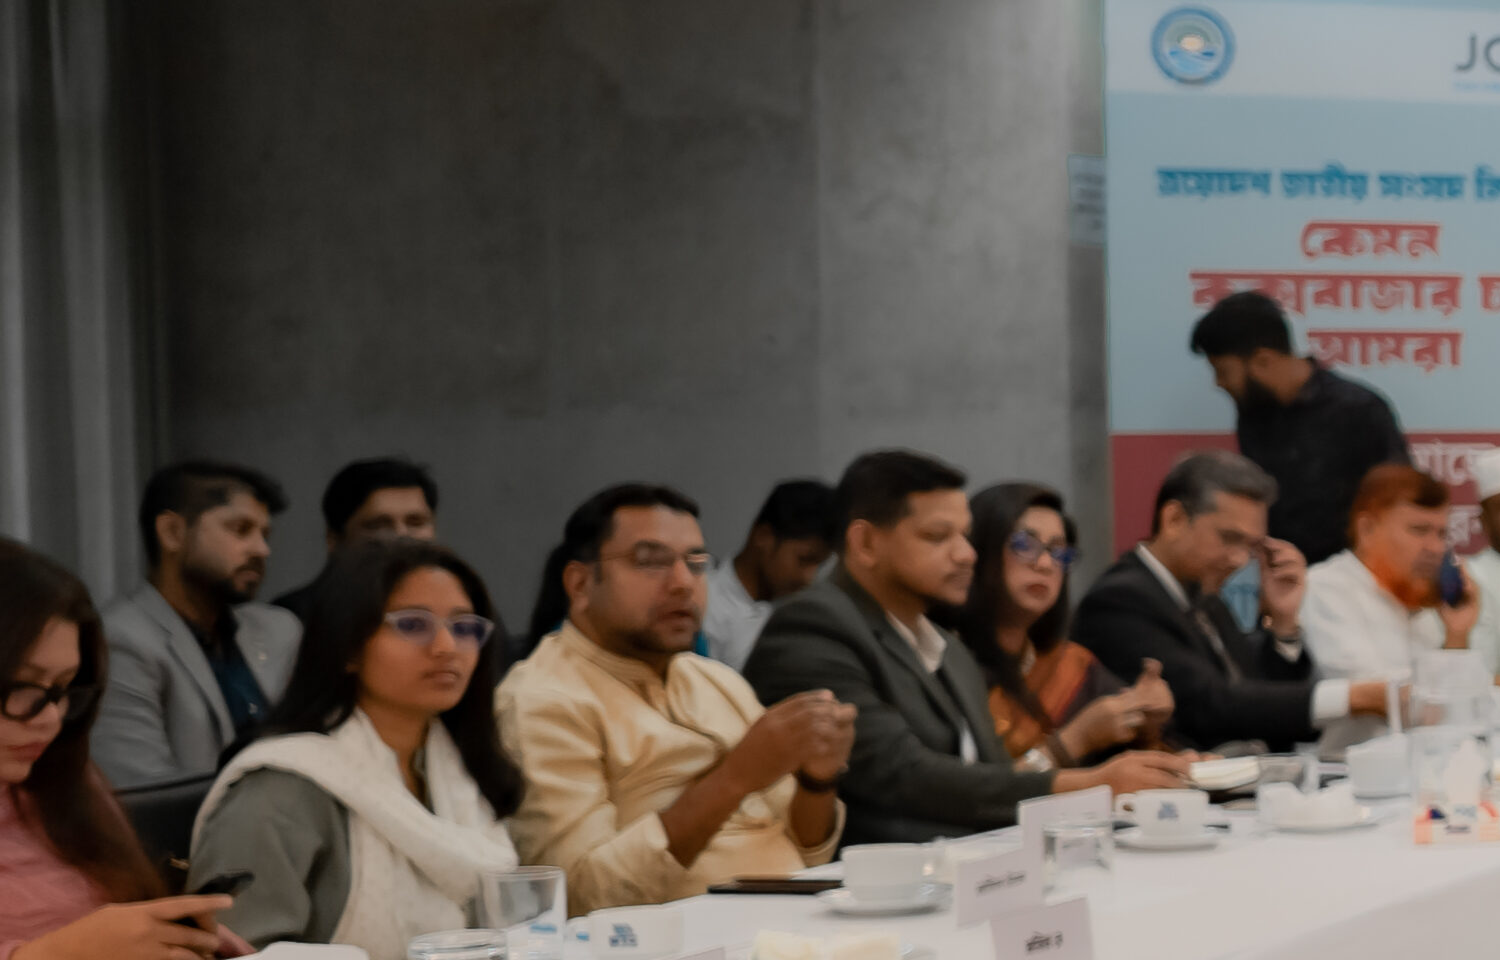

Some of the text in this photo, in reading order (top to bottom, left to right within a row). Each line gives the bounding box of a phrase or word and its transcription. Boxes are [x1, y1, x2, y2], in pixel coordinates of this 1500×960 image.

[1280, 162, 1369, 201] জাতীয়
[1379, 173, 1466, 199] সংসদ
[1300, 221, 1441, 259] কেমন
[1307, 330, 1464, 373] আমরা
